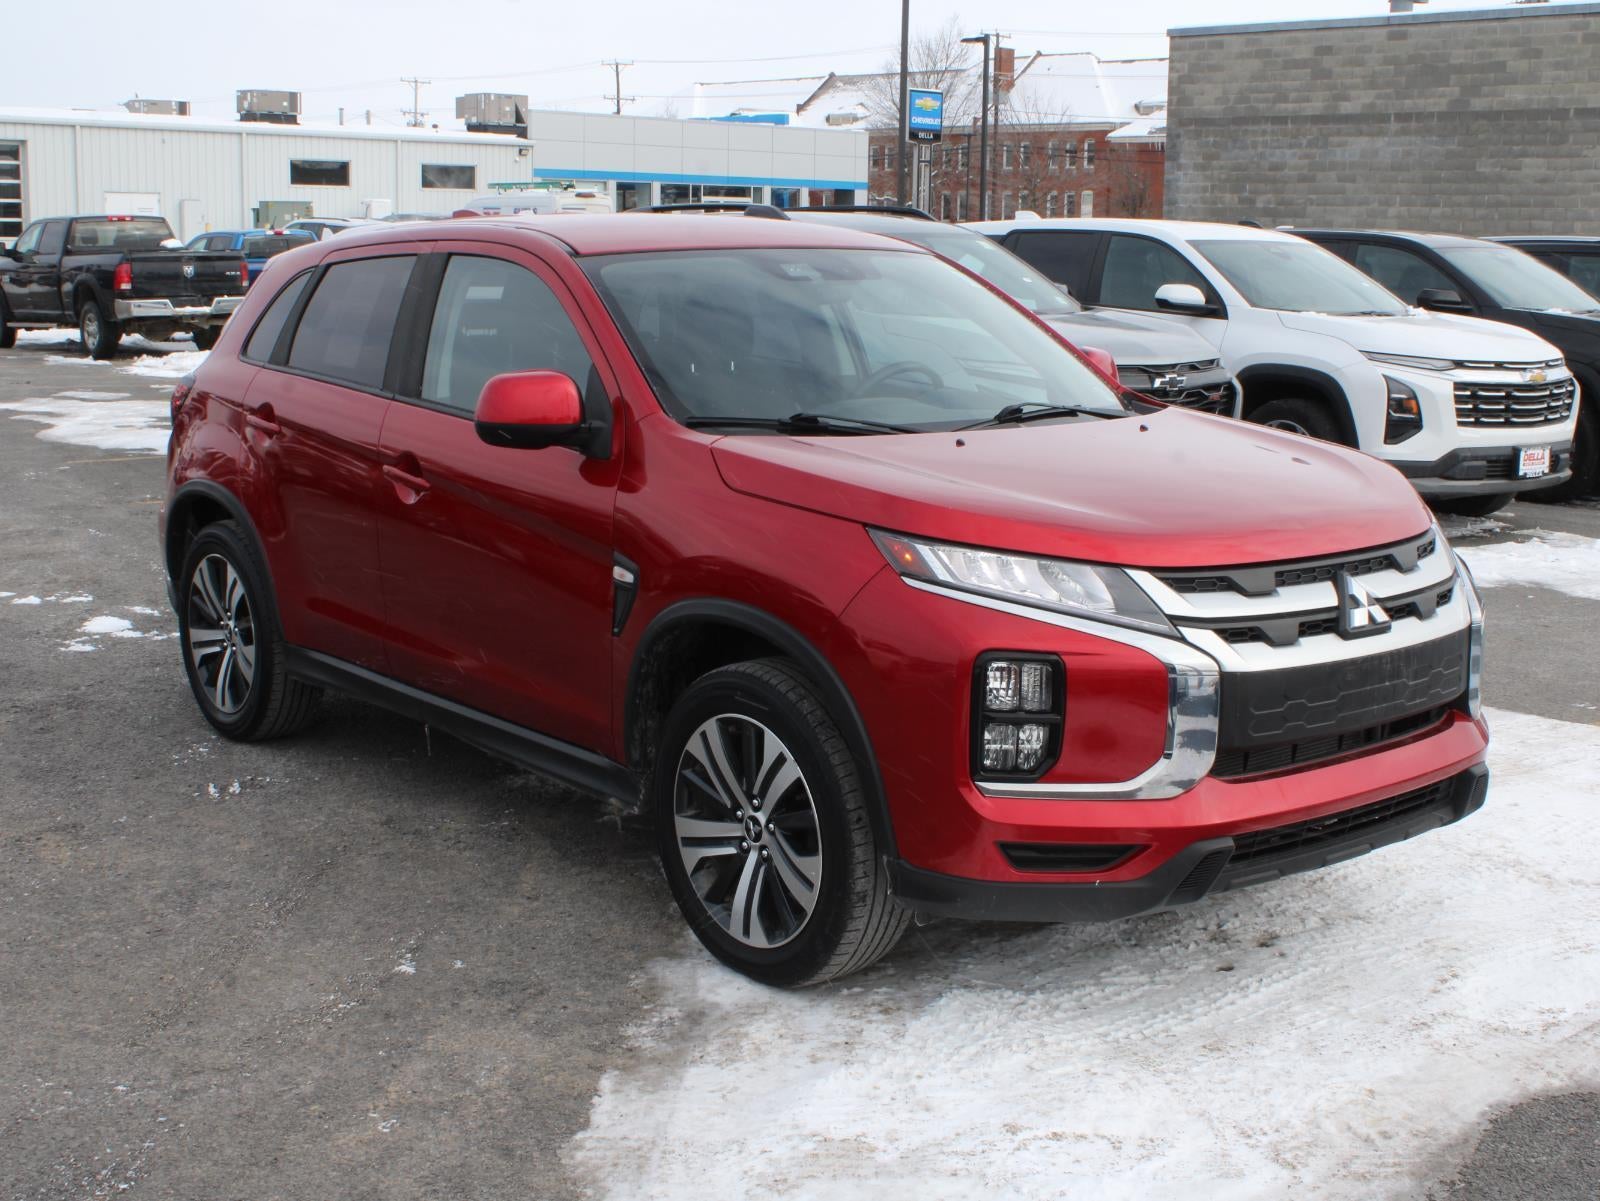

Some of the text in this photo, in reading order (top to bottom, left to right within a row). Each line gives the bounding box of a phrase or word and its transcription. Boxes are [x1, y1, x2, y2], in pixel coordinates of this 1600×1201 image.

[911, 116, 941, 125] CHEVROLET
[918, 131, 934, 139] DELLA
[1523, 450, 1545, 462] DELLA
